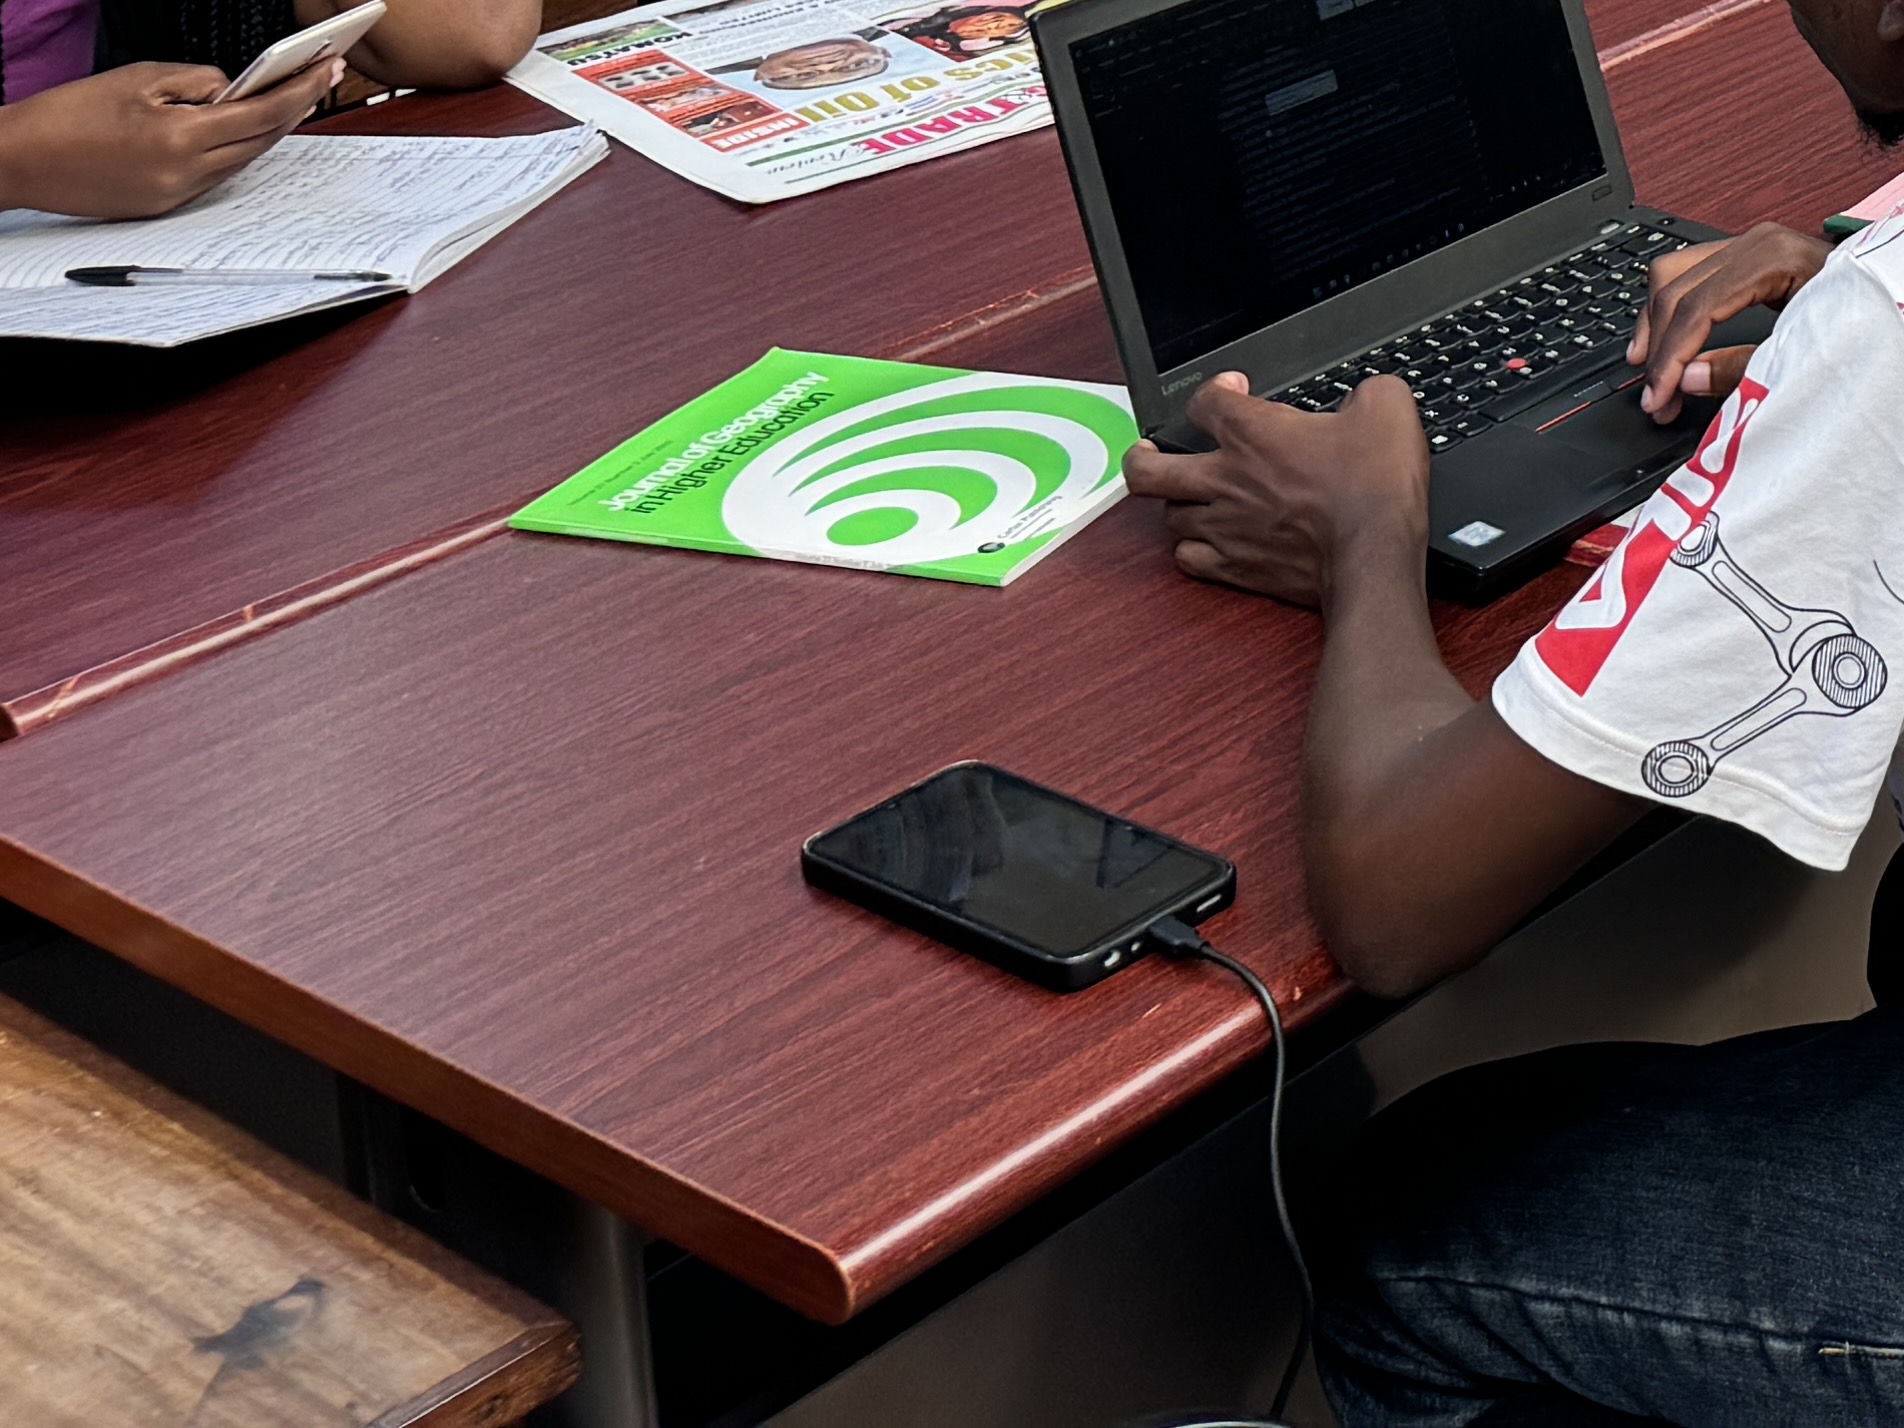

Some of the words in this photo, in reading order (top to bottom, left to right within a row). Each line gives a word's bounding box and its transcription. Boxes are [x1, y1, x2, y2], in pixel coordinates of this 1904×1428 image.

[566, 30, 692, 70] KOMATSU
[794, 90, 879, 126] Oil
[880, 74, 940, 105] of
[705, 116, 800, 150] INSIDE
[852, 97, 1014, 156] TRADE
[1161, 370, 1203, 397] Lenovo
[598, 450, 691, 513] Journal
[687, 431, 711, 461] of
[704, 370, 831, 445] Geography
[625, 489, 661, 516] in
[654, 452, 733, 507] Higher
[728, 389, 835, 459] Education
